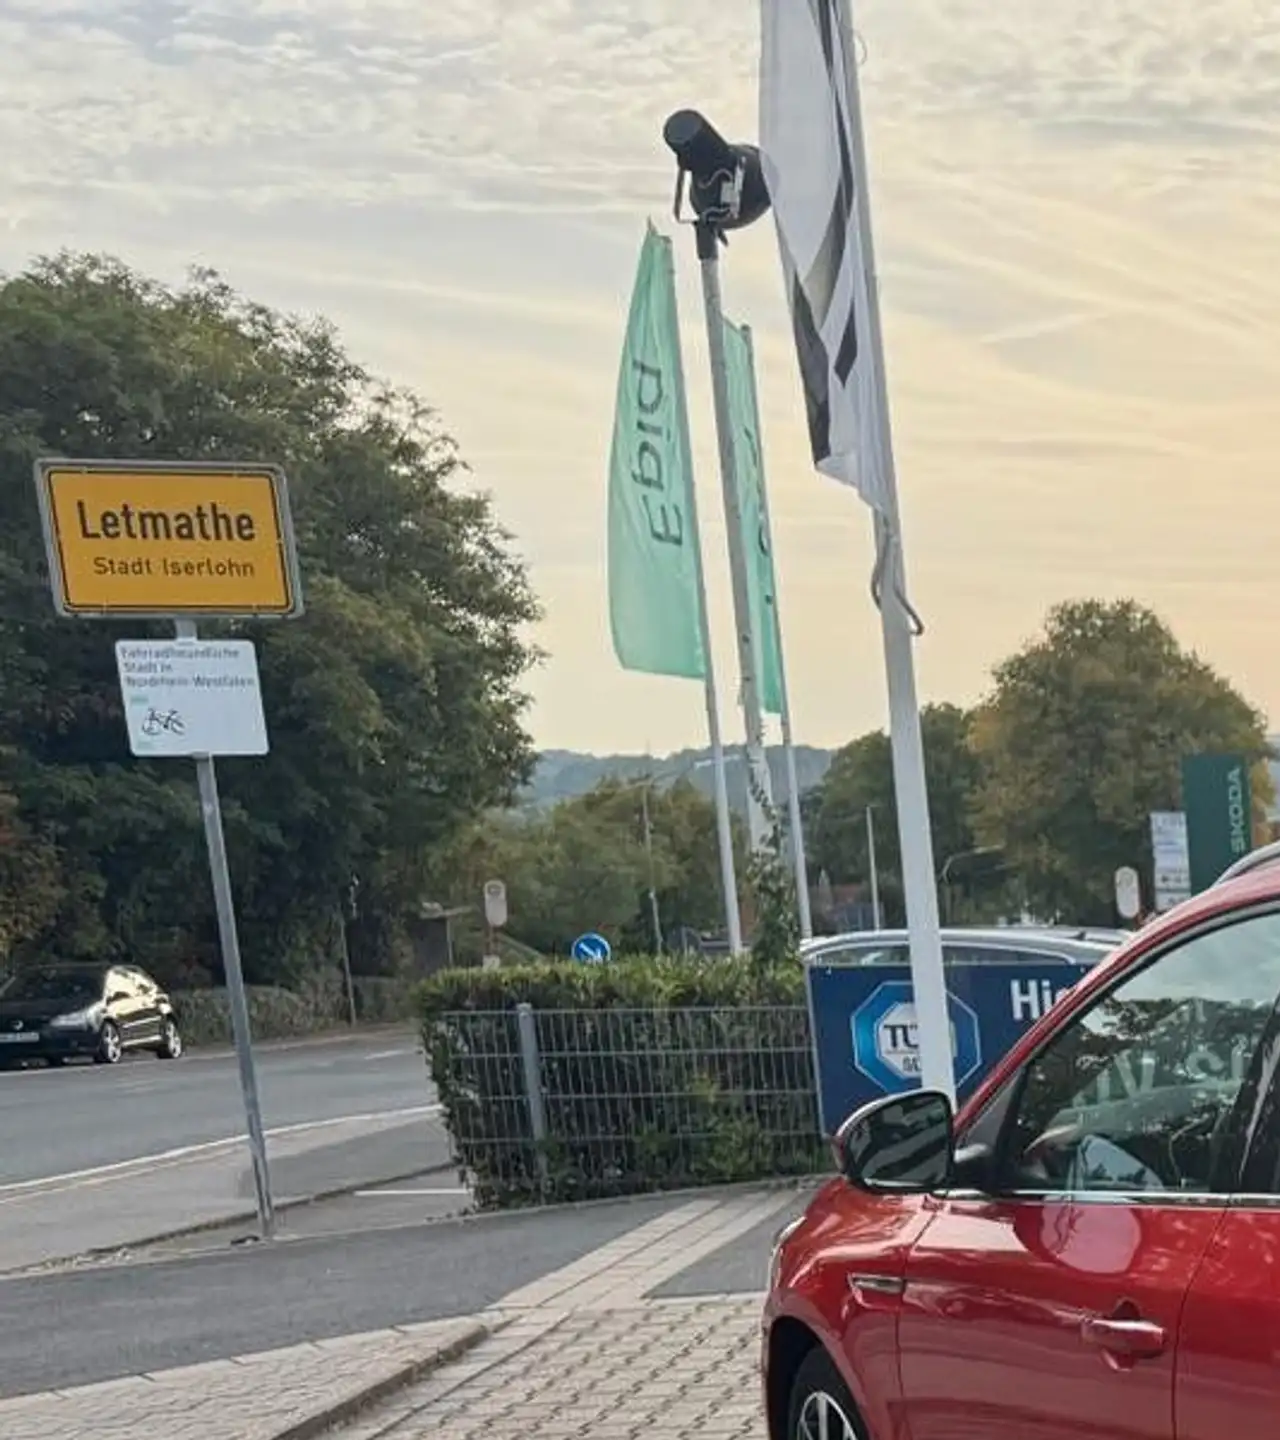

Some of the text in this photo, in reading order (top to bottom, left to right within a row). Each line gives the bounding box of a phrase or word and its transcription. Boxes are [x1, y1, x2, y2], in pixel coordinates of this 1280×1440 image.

[77, 500, 256, 541] Letmathe
[93, 557, 256, 577] Stadt Iserlohn
[1011, 979, 1068, 1020] Hi
[884, 1024, 919, 1049] TÜ
